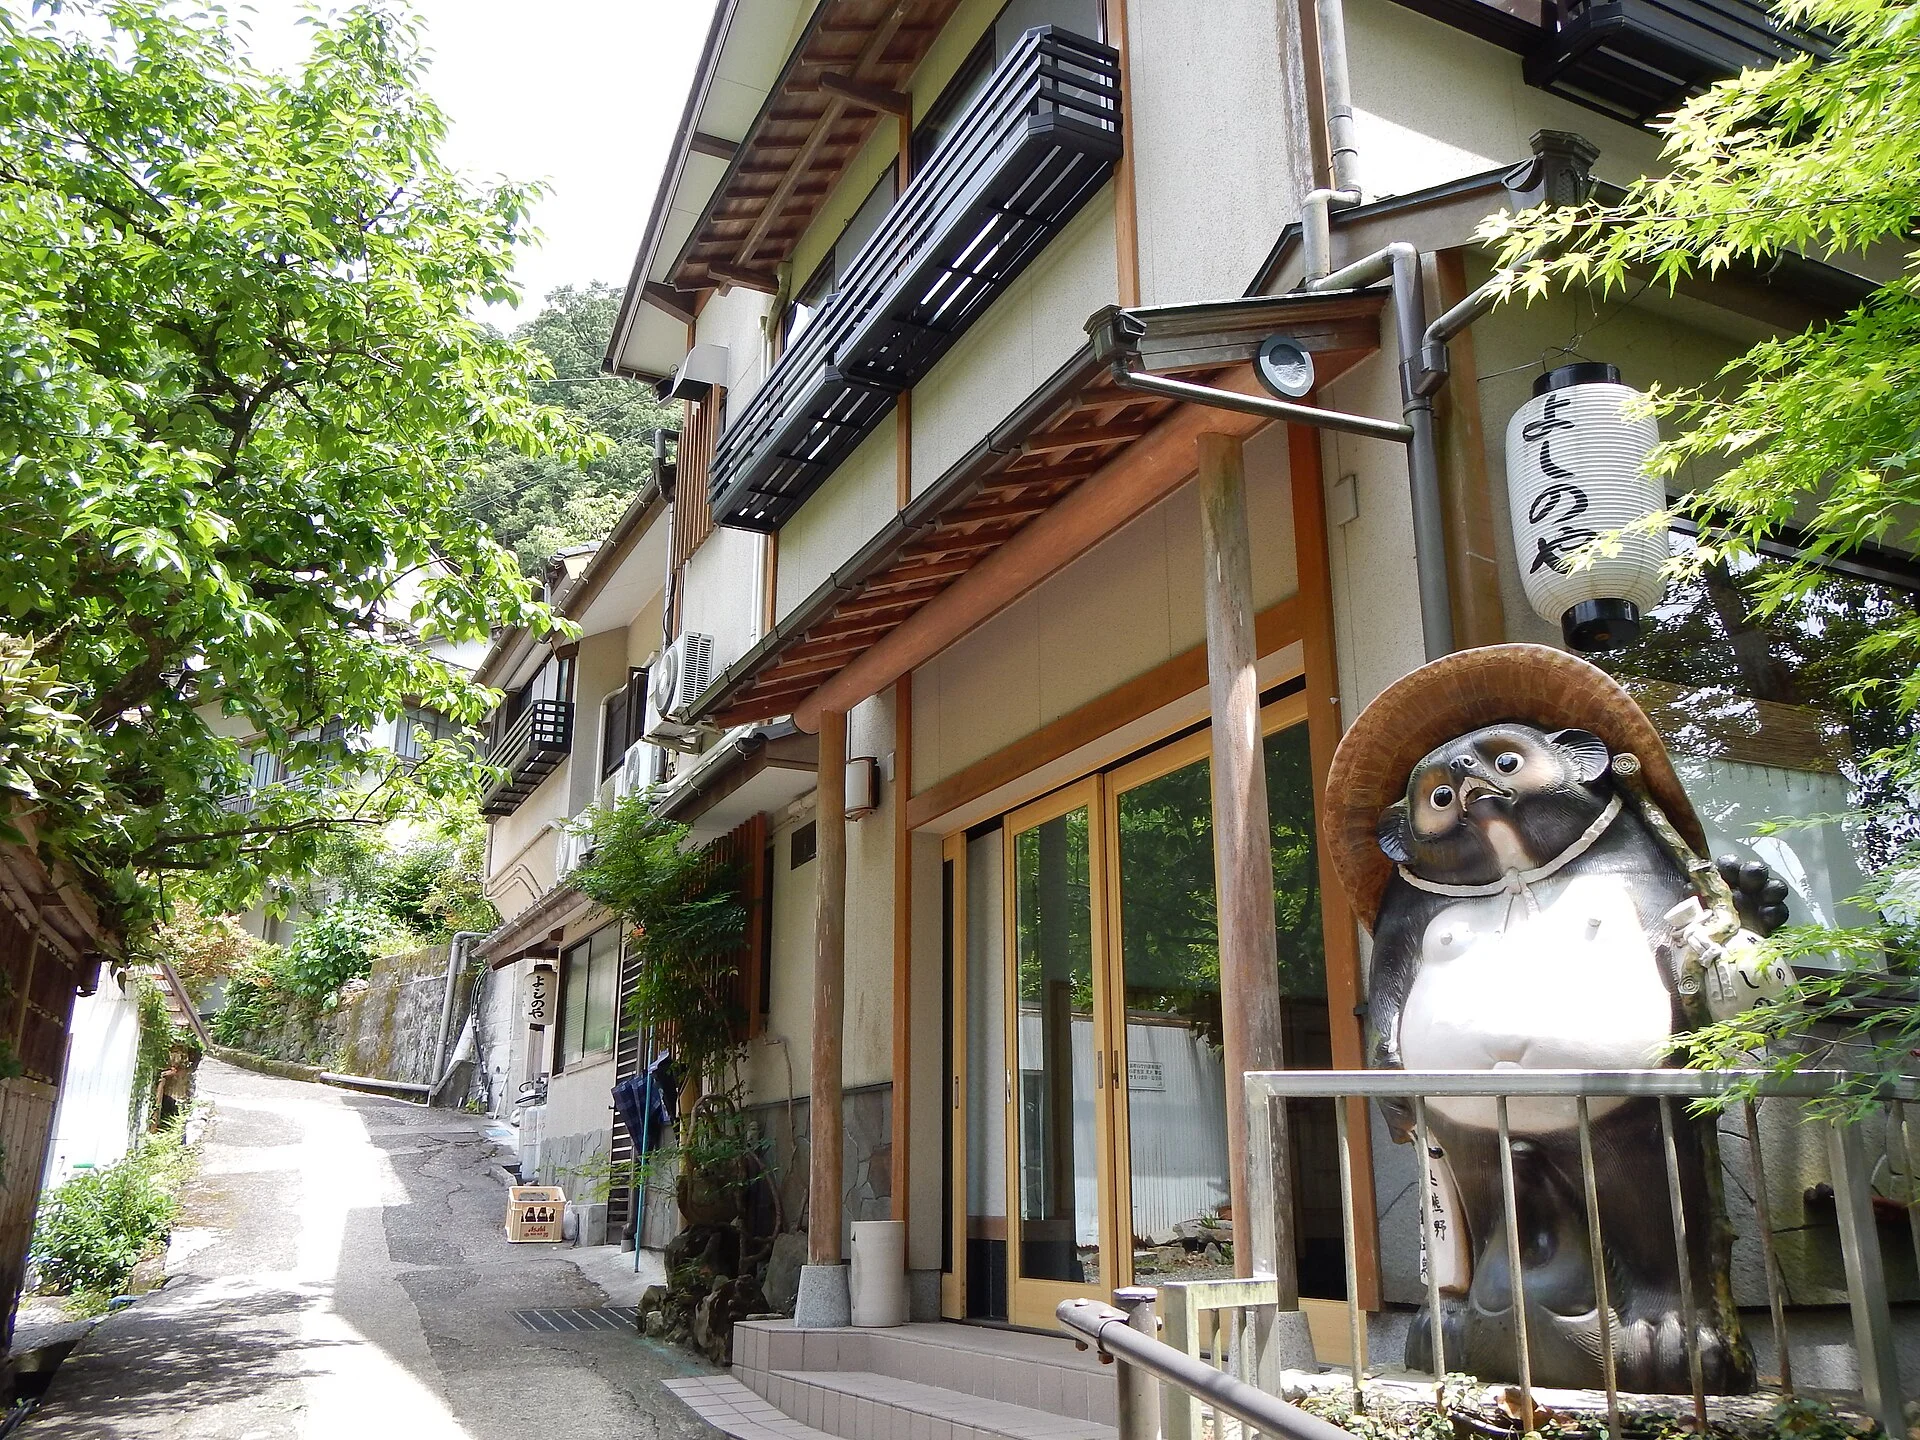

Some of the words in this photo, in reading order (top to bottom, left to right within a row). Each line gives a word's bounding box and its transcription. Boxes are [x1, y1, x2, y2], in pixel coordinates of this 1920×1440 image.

[1522, 394, 1598, 575] よしのや
[528, 975, 546, 1020] よしのや
